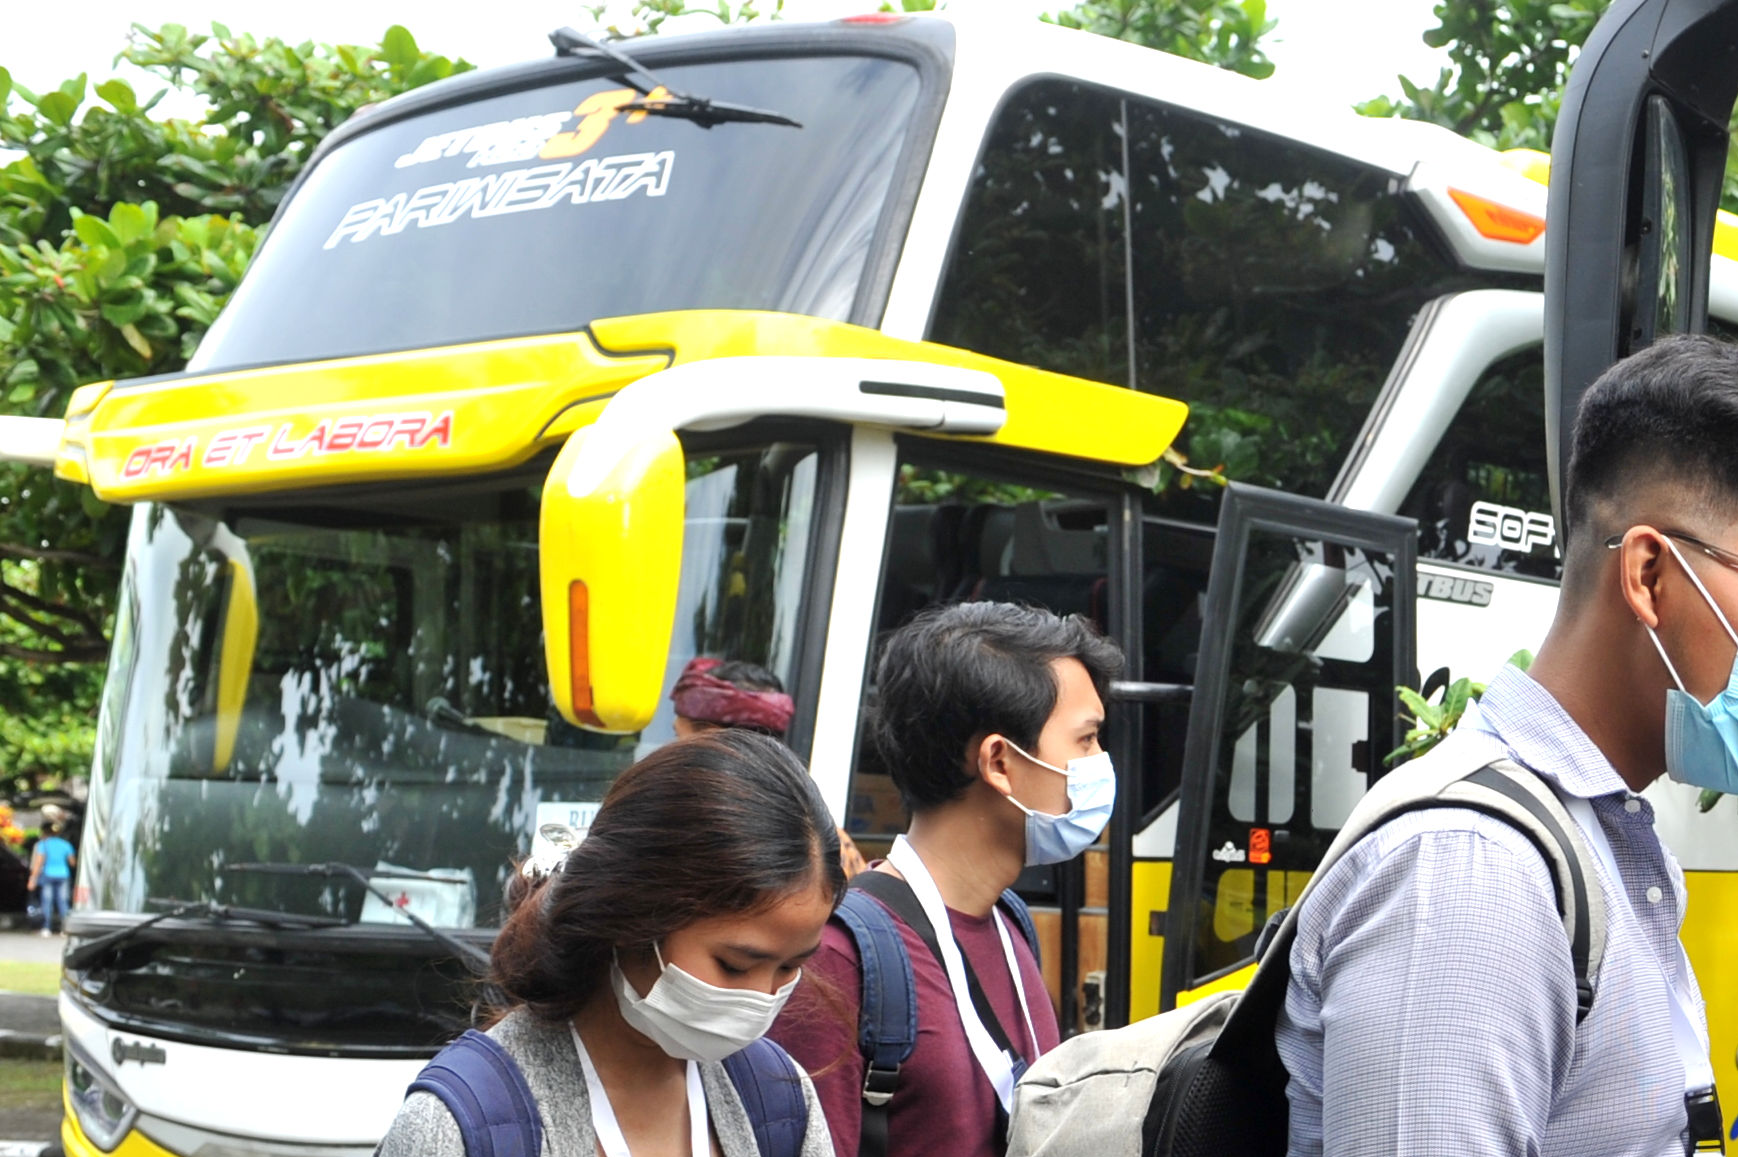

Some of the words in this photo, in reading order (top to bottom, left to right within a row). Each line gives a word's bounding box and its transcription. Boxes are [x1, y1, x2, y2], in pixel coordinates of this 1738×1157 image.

[323, 151, 675, 249] PARIWISATA
[122, 436, 196, 481] ORA
[203, 426, 270, 467] ET
[268, 411, 453, 460] LABORA
[1467, 501, 1559, 557] SOF
[1416, 571, 1494, 607] TBUS
